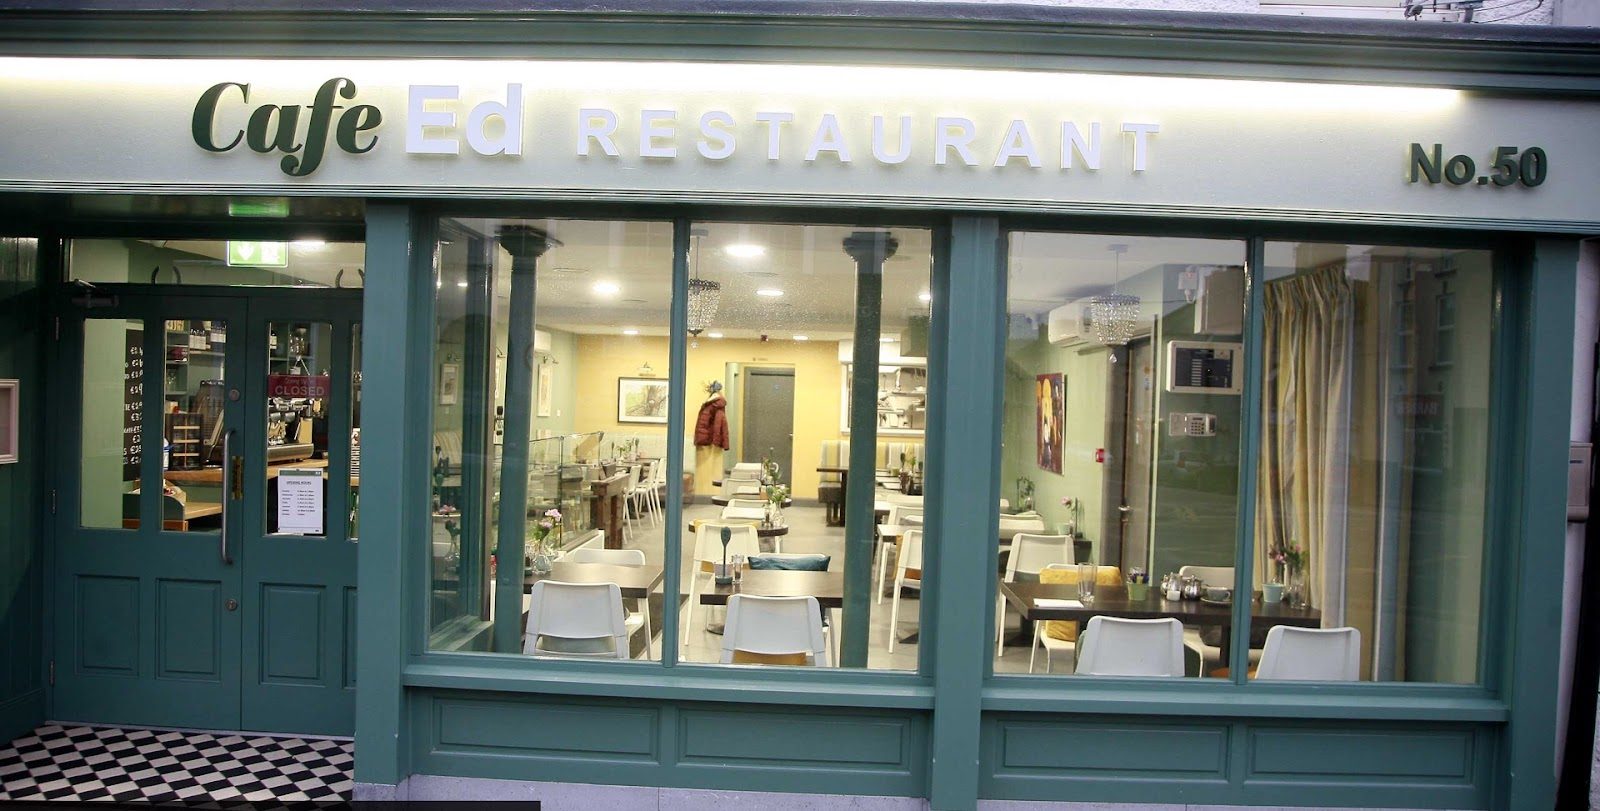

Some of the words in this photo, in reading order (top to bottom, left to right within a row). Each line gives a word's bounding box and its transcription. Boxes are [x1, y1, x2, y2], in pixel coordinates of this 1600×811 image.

[191, 77, 383, 177] Cafe
[405, 83, 523, 157] Ed
[576, 107, 1160, 173] RESTAURANT
[1408, 142, 1548, 188] No.50
[275, 385, 325, 396] CLOSED
